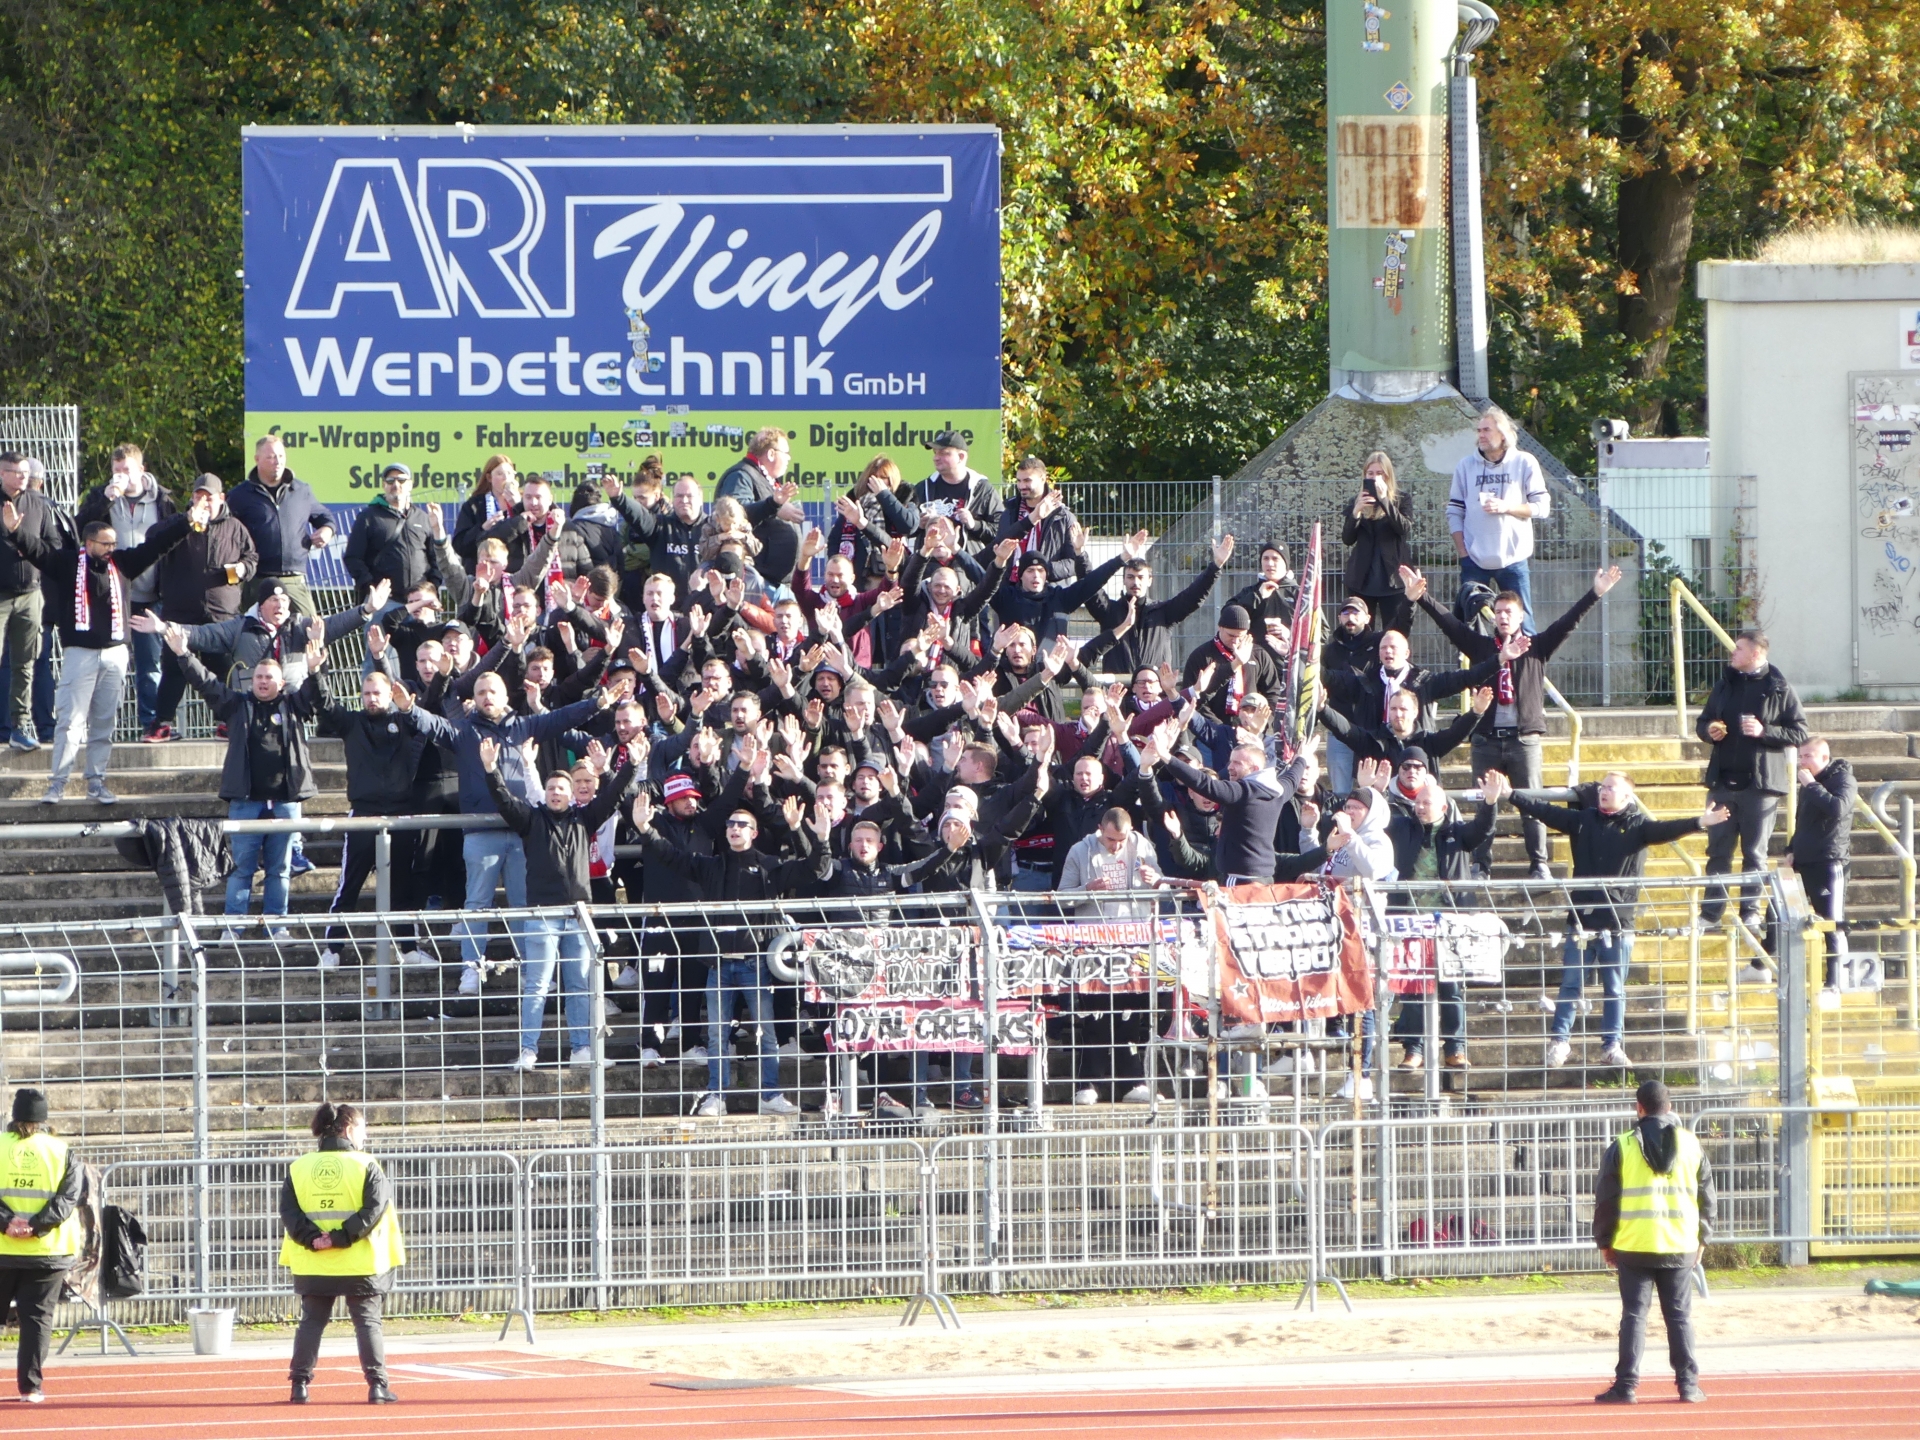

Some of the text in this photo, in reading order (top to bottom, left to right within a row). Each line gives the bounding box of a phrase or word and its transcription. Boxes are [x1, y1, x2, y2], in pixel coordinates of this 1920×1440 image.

[593, 201, 943, 348] Vinyl
[284, 336, 835, 397] Werbetechnik
[843, 372, 926, 396] GmbH
[998, 953, 1132, 990] BANDE
[1842, 958, 1878, 989] 12
[13, 1177, 34, 1188] 194
[318, 1168, 336, 1177] ZKS
[319, 1199, 334, 1209] 52
